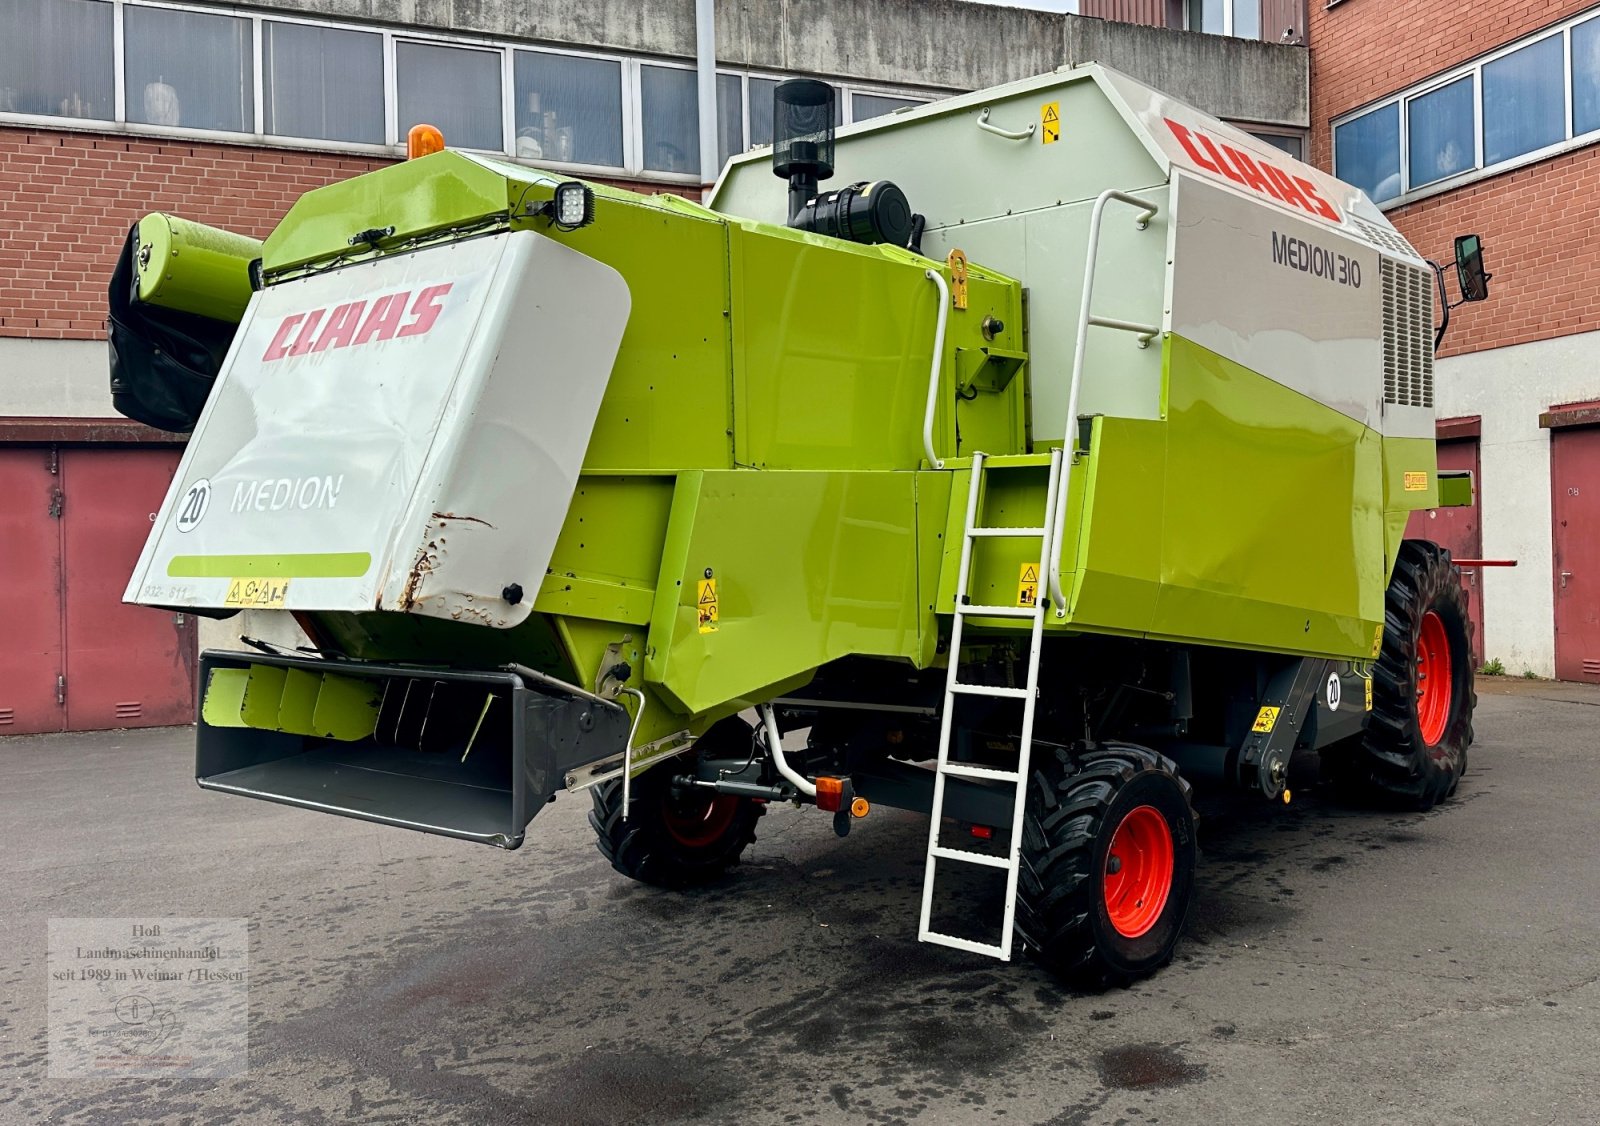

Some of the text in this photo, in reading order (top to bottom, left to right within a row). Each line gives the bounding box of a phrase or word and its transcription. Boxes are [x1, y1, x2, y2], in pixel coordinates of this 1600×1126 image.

[1163, 117, 1342, 224] CLAAS
[1271, 231, 1361, 289] MEDION 310
[261, 282, 454, 363] CLAAS
[179, 486, 206, 524] 20
[230, 474, 344, 513] MEDION
[1329, 679, 1339, 704] 20
